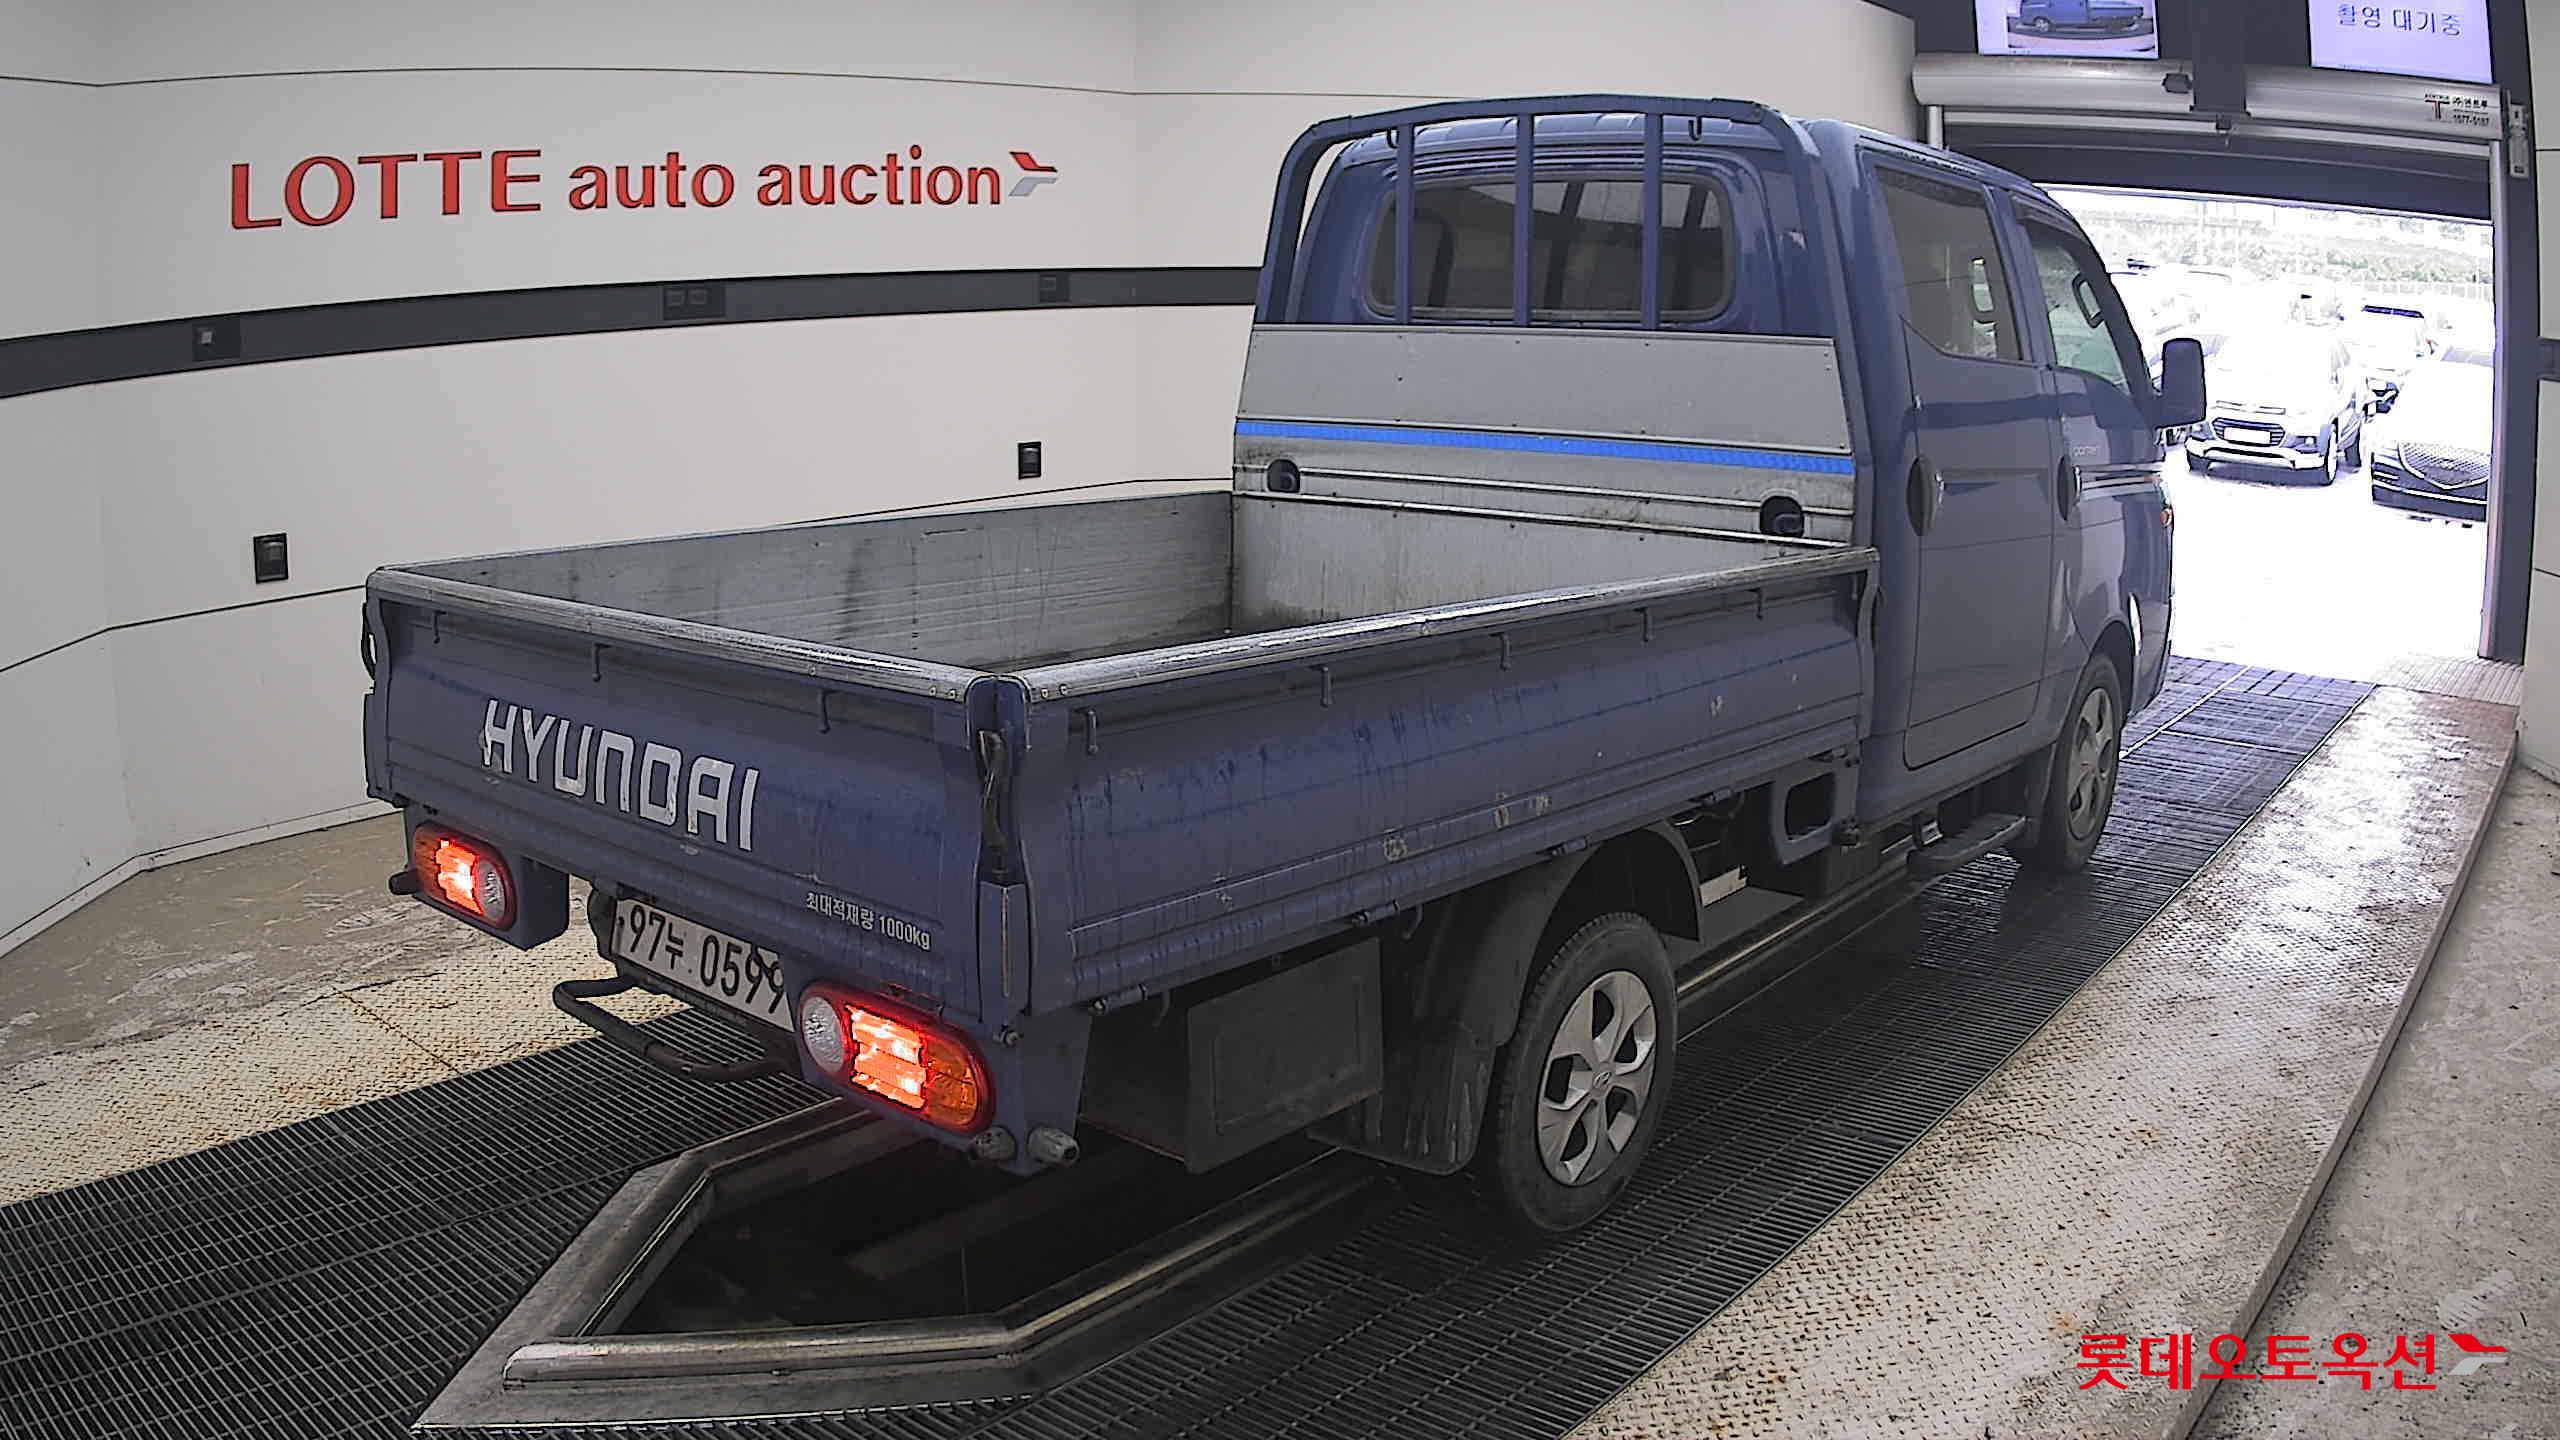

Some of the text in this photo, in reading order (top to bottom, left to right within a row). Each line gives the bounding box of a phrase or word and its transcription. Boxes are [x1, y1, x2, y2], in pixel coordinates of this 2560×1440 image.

[2393, 9, 2460, 36] 대기중
[231, 145, 1002, 230] LOTTE auto auction
[482, 699, 760, 852] HYUNDAI
[630, 904, 785, 1015] 97누 0599
[806, 892, 930, 951] 최대적재량 1000kg
